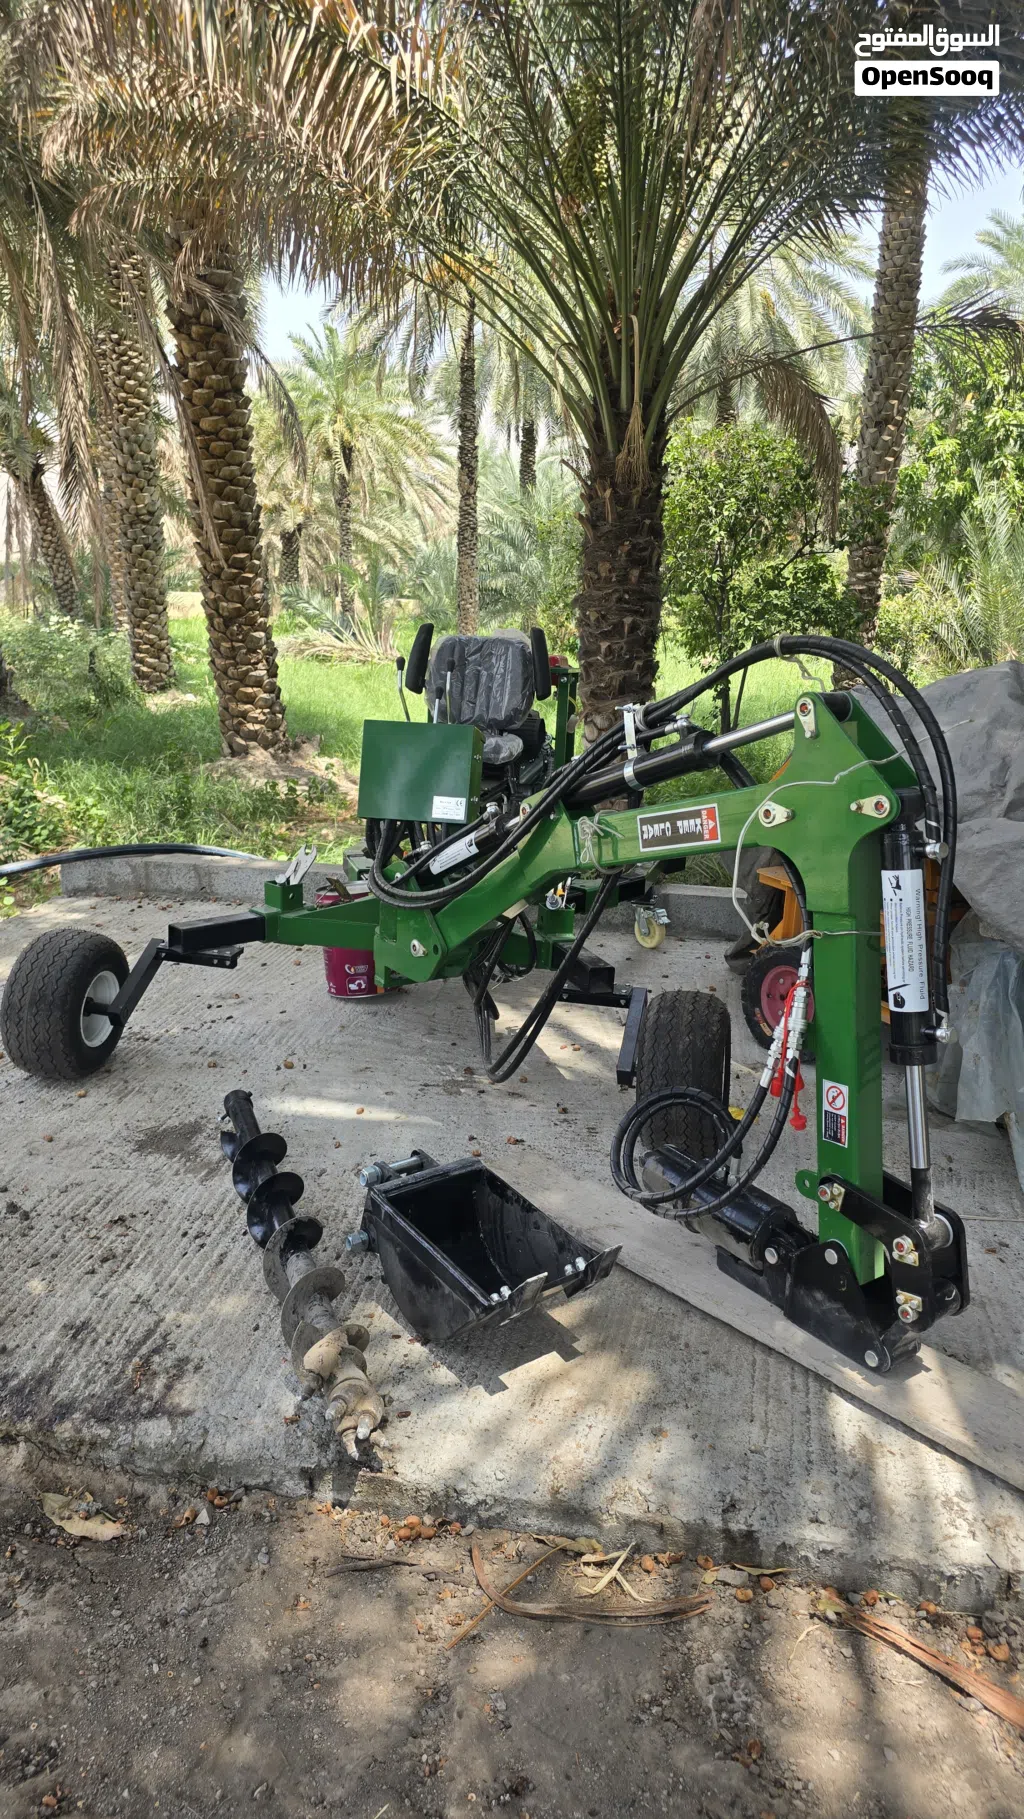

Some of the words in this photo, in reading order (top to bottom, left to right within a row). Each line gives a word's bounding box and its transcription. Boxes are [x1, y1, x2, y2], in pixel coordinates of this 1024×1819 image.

[642, 821, 672, 840] CLEAR
[676, 817, 703, 835] KEEP
[701, 810, 709, 840] DANGER
[906, 918, 914, 940] PRESSURE
[916, 924, 924, 941] High
[907, 954, 915, 972] HAZARD
